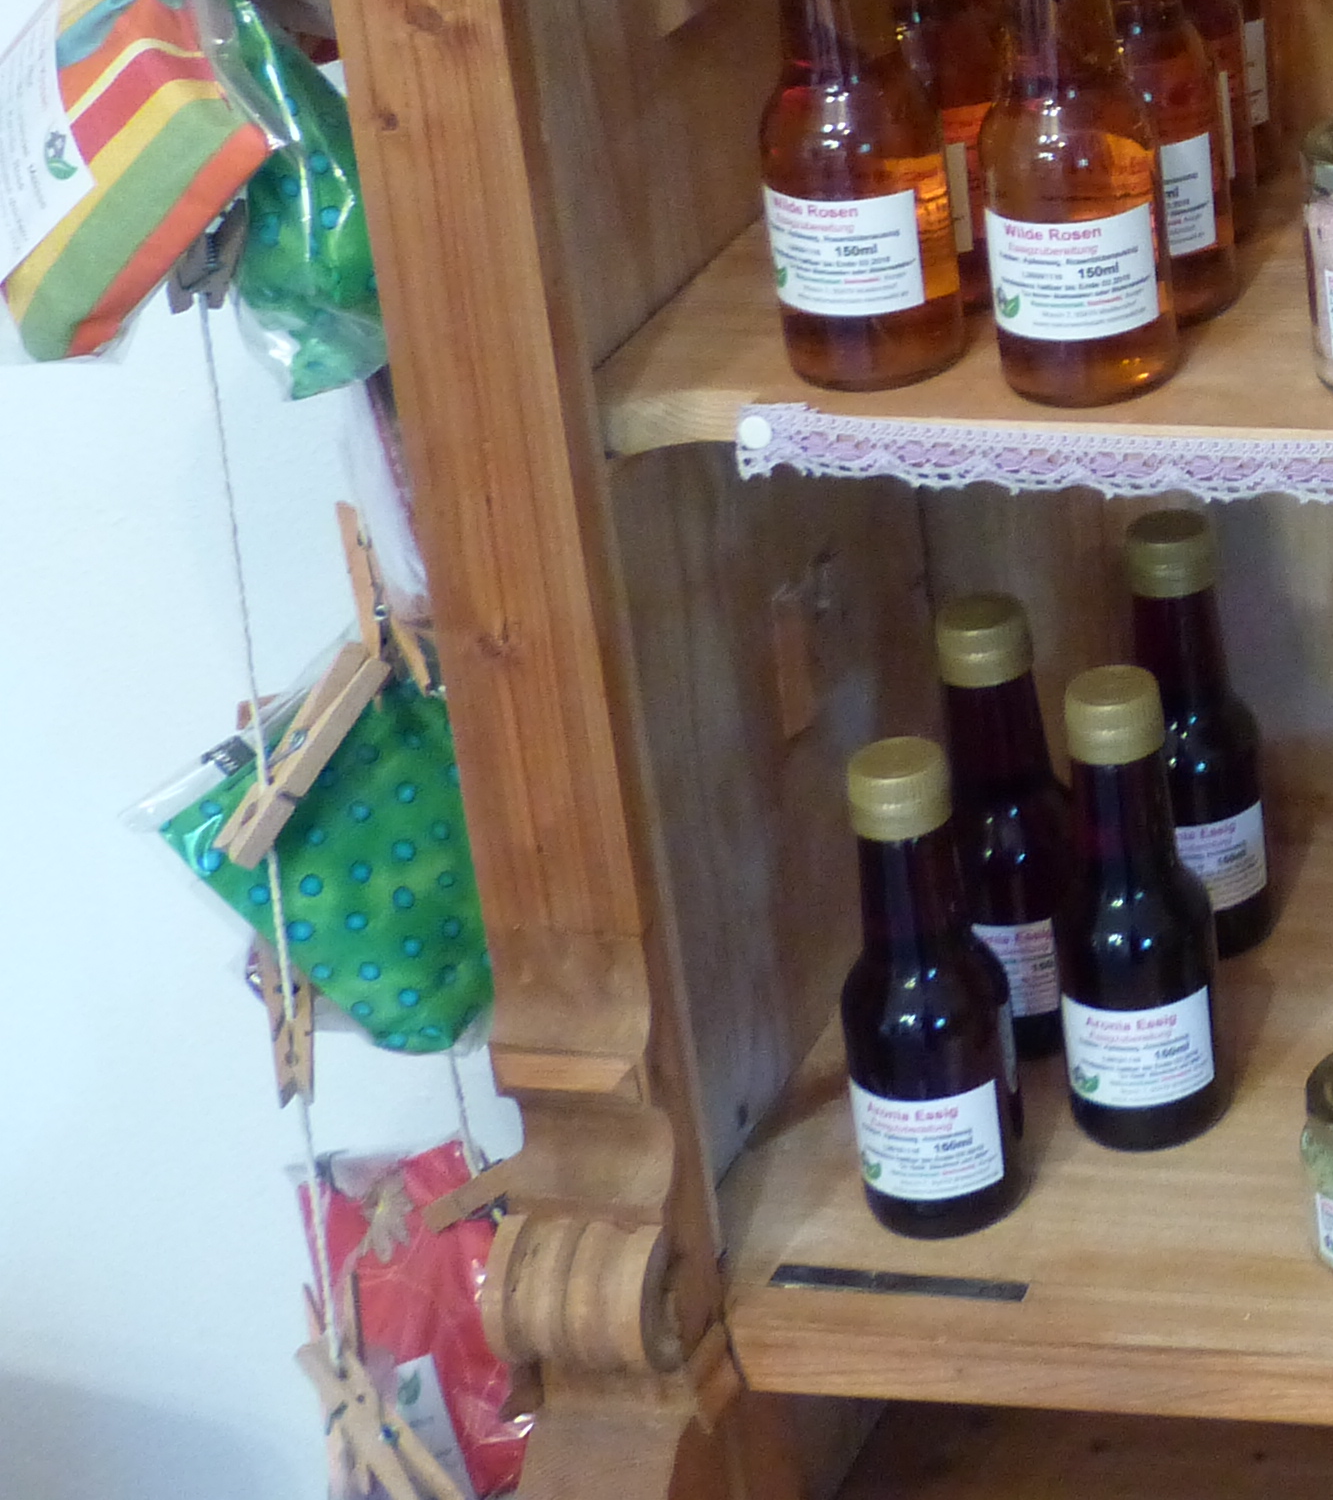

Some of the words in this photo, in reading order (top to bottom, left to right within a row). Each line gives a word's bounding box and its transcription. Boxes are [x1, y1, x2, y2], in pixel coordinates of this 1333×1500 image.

[808, 205, 859, 218] Rosen
[1004, 224, 1043, 239] Wilde
[1049, 227, 1101, 241] Rosen
[834, 244, 878, 257] 150ml
[1078, 262, 1119, 278] 150ml
[1136, 1014, 1177, 1030] Essig
[915, 1107, 958, 1121] Essig
